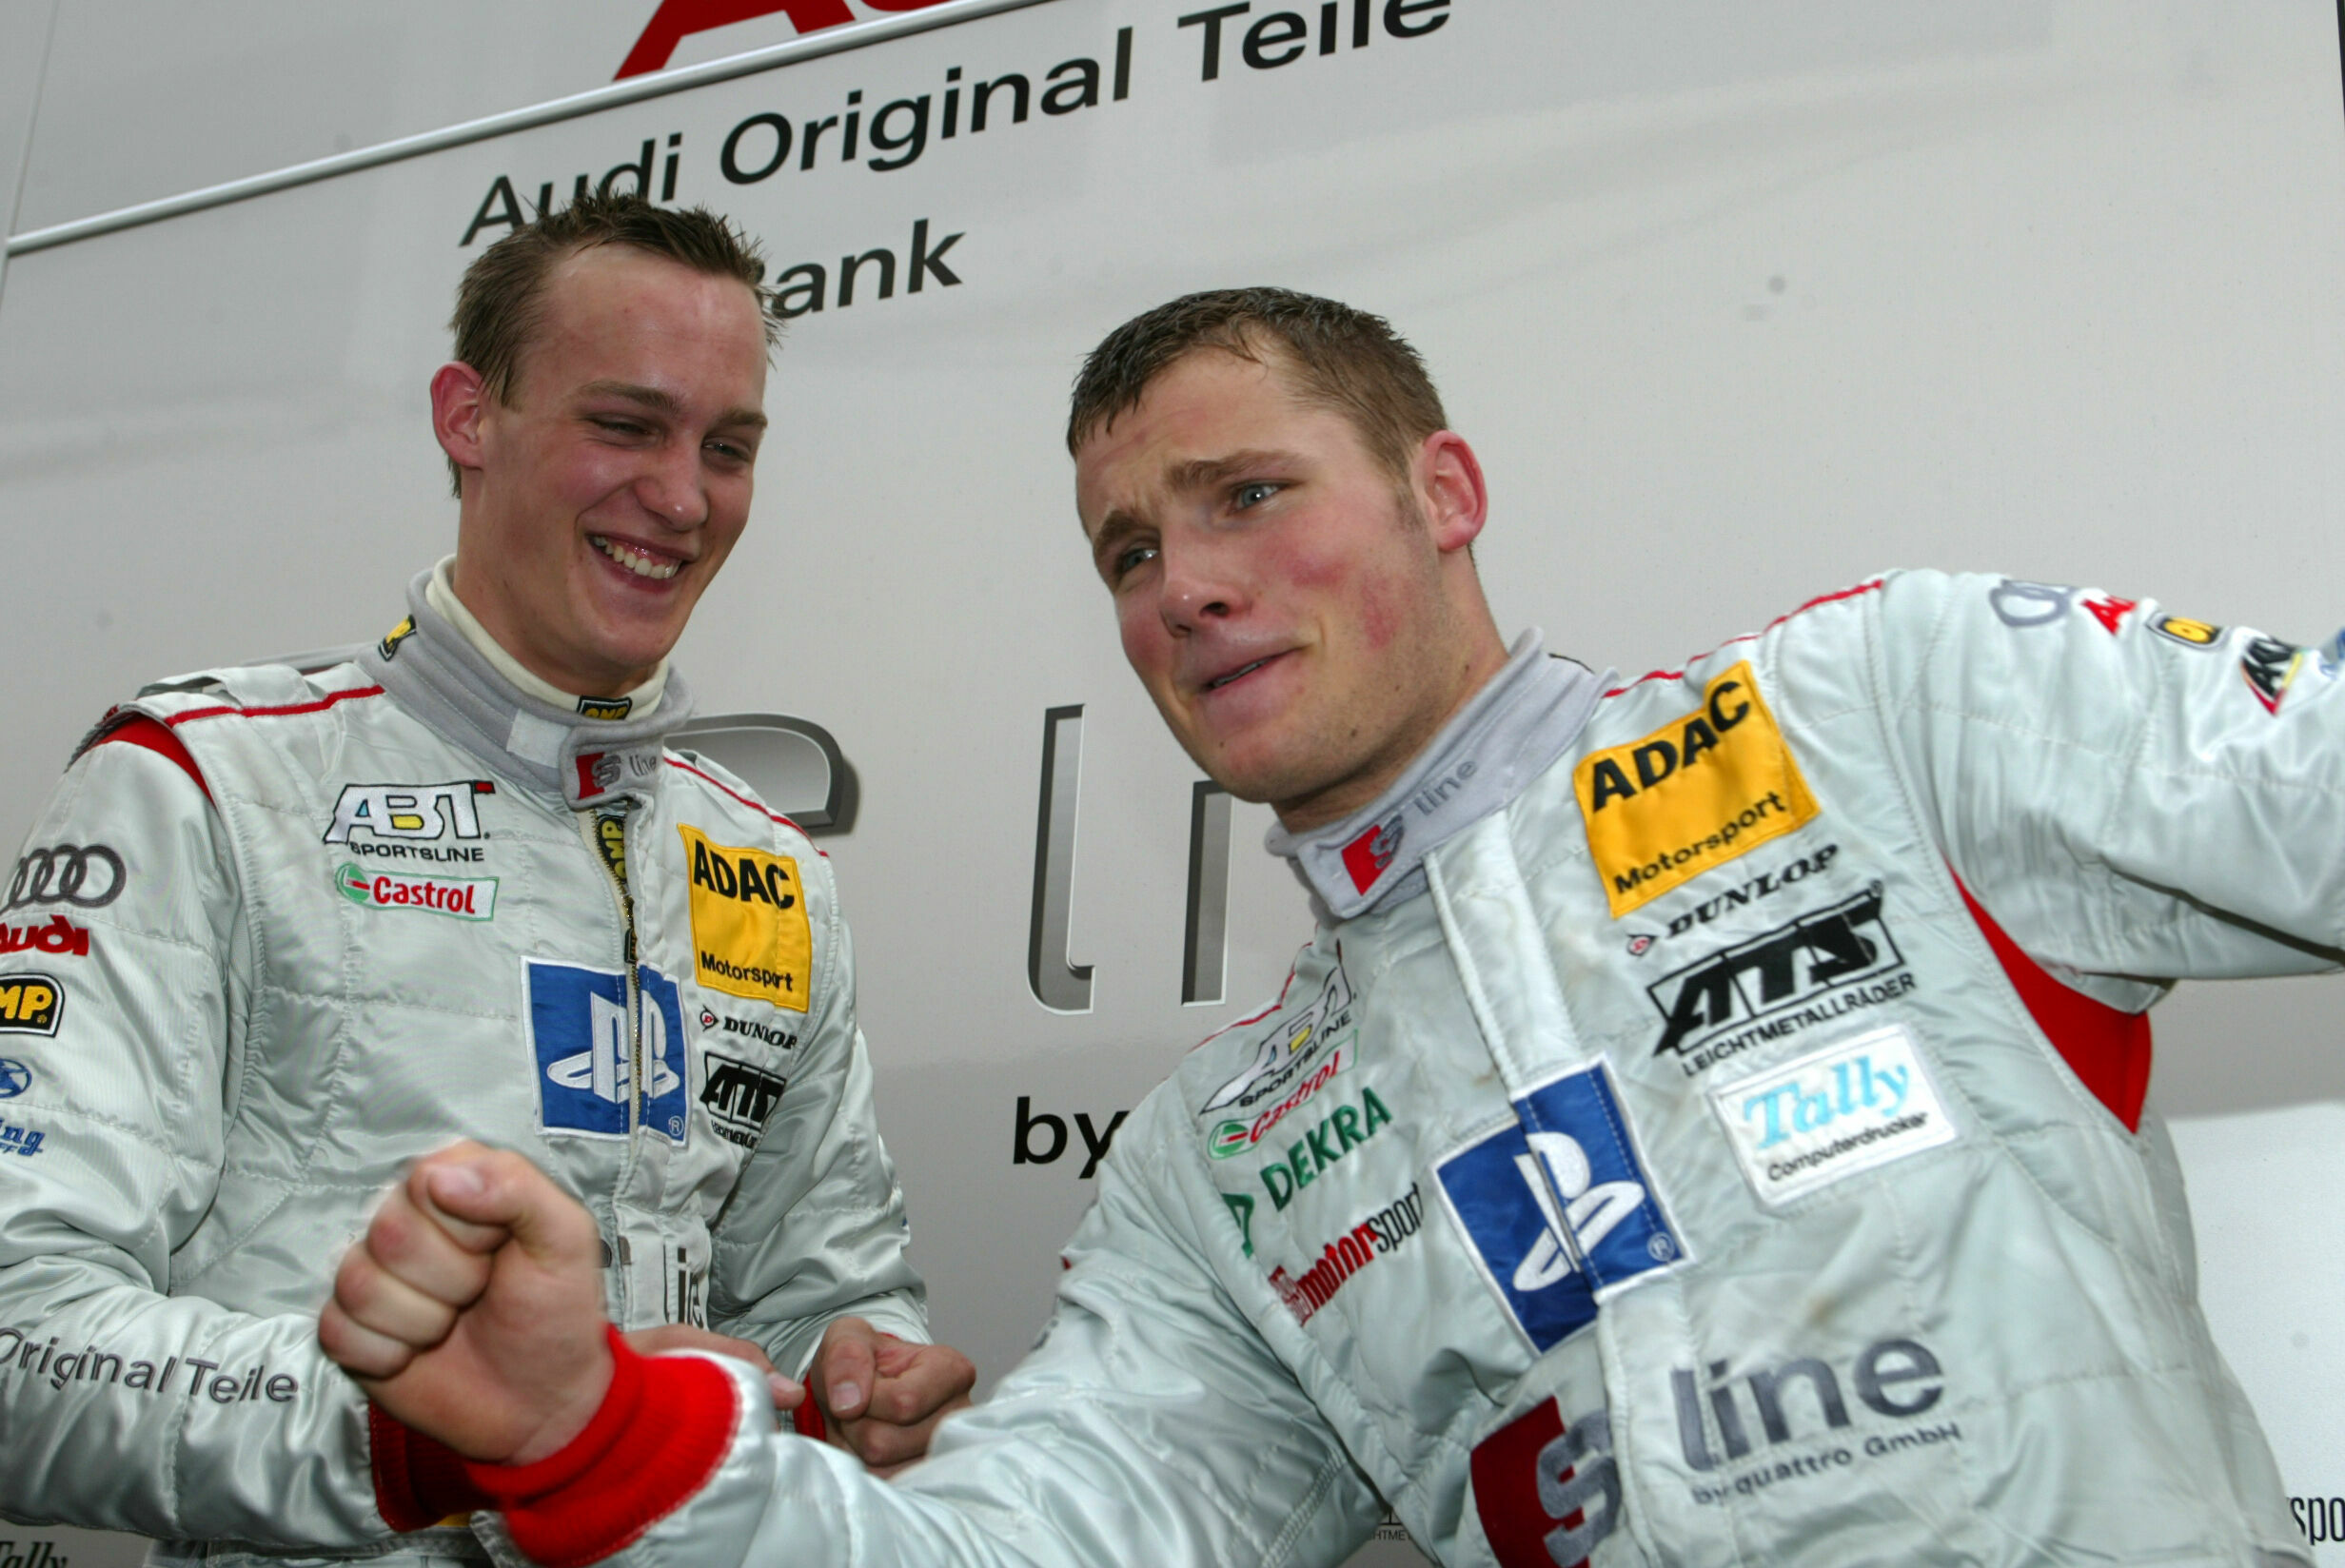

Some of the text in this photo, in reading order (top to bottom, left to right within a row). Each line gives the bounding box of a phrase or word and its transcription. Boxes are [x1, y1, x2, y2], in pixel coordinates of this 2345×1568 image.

[719, 26, 1133, 185] Original
[1177, 0, 1451, 83] Teile
[758, 218, 966, 320] ank
[1412, 760, 1478, 816] line
[1591, 680, 1751, 814] ADAC
[322, 779, 496, 845] ABT
[349, 841, 485, 863] SPORTSLINE
[1612, 791, 1787, 895] Motorsport
[372, 875, 476, 914] Castrol
[693, 838, 796, 911] ADAC
[1666, 843, 1840, 939] DUNLOP
[0, 985, 53, 1021] MP
[700, 950, 794, 992] Motorsport
[1651, 889, 1902, 1056] ATS
[1013, 1095, 1131, 1180] by
[1743, 1054, 1910, 1150] Tally
[1259, 1087, 1393, 1213] DEKRA
[186, 1351, 299, 1403] Teile
[1669, 1337, 1946, 1475] line
[1734, 1448, 1852, 1496] quattro
[1863, 1421, 1963, 1459] GmbH
